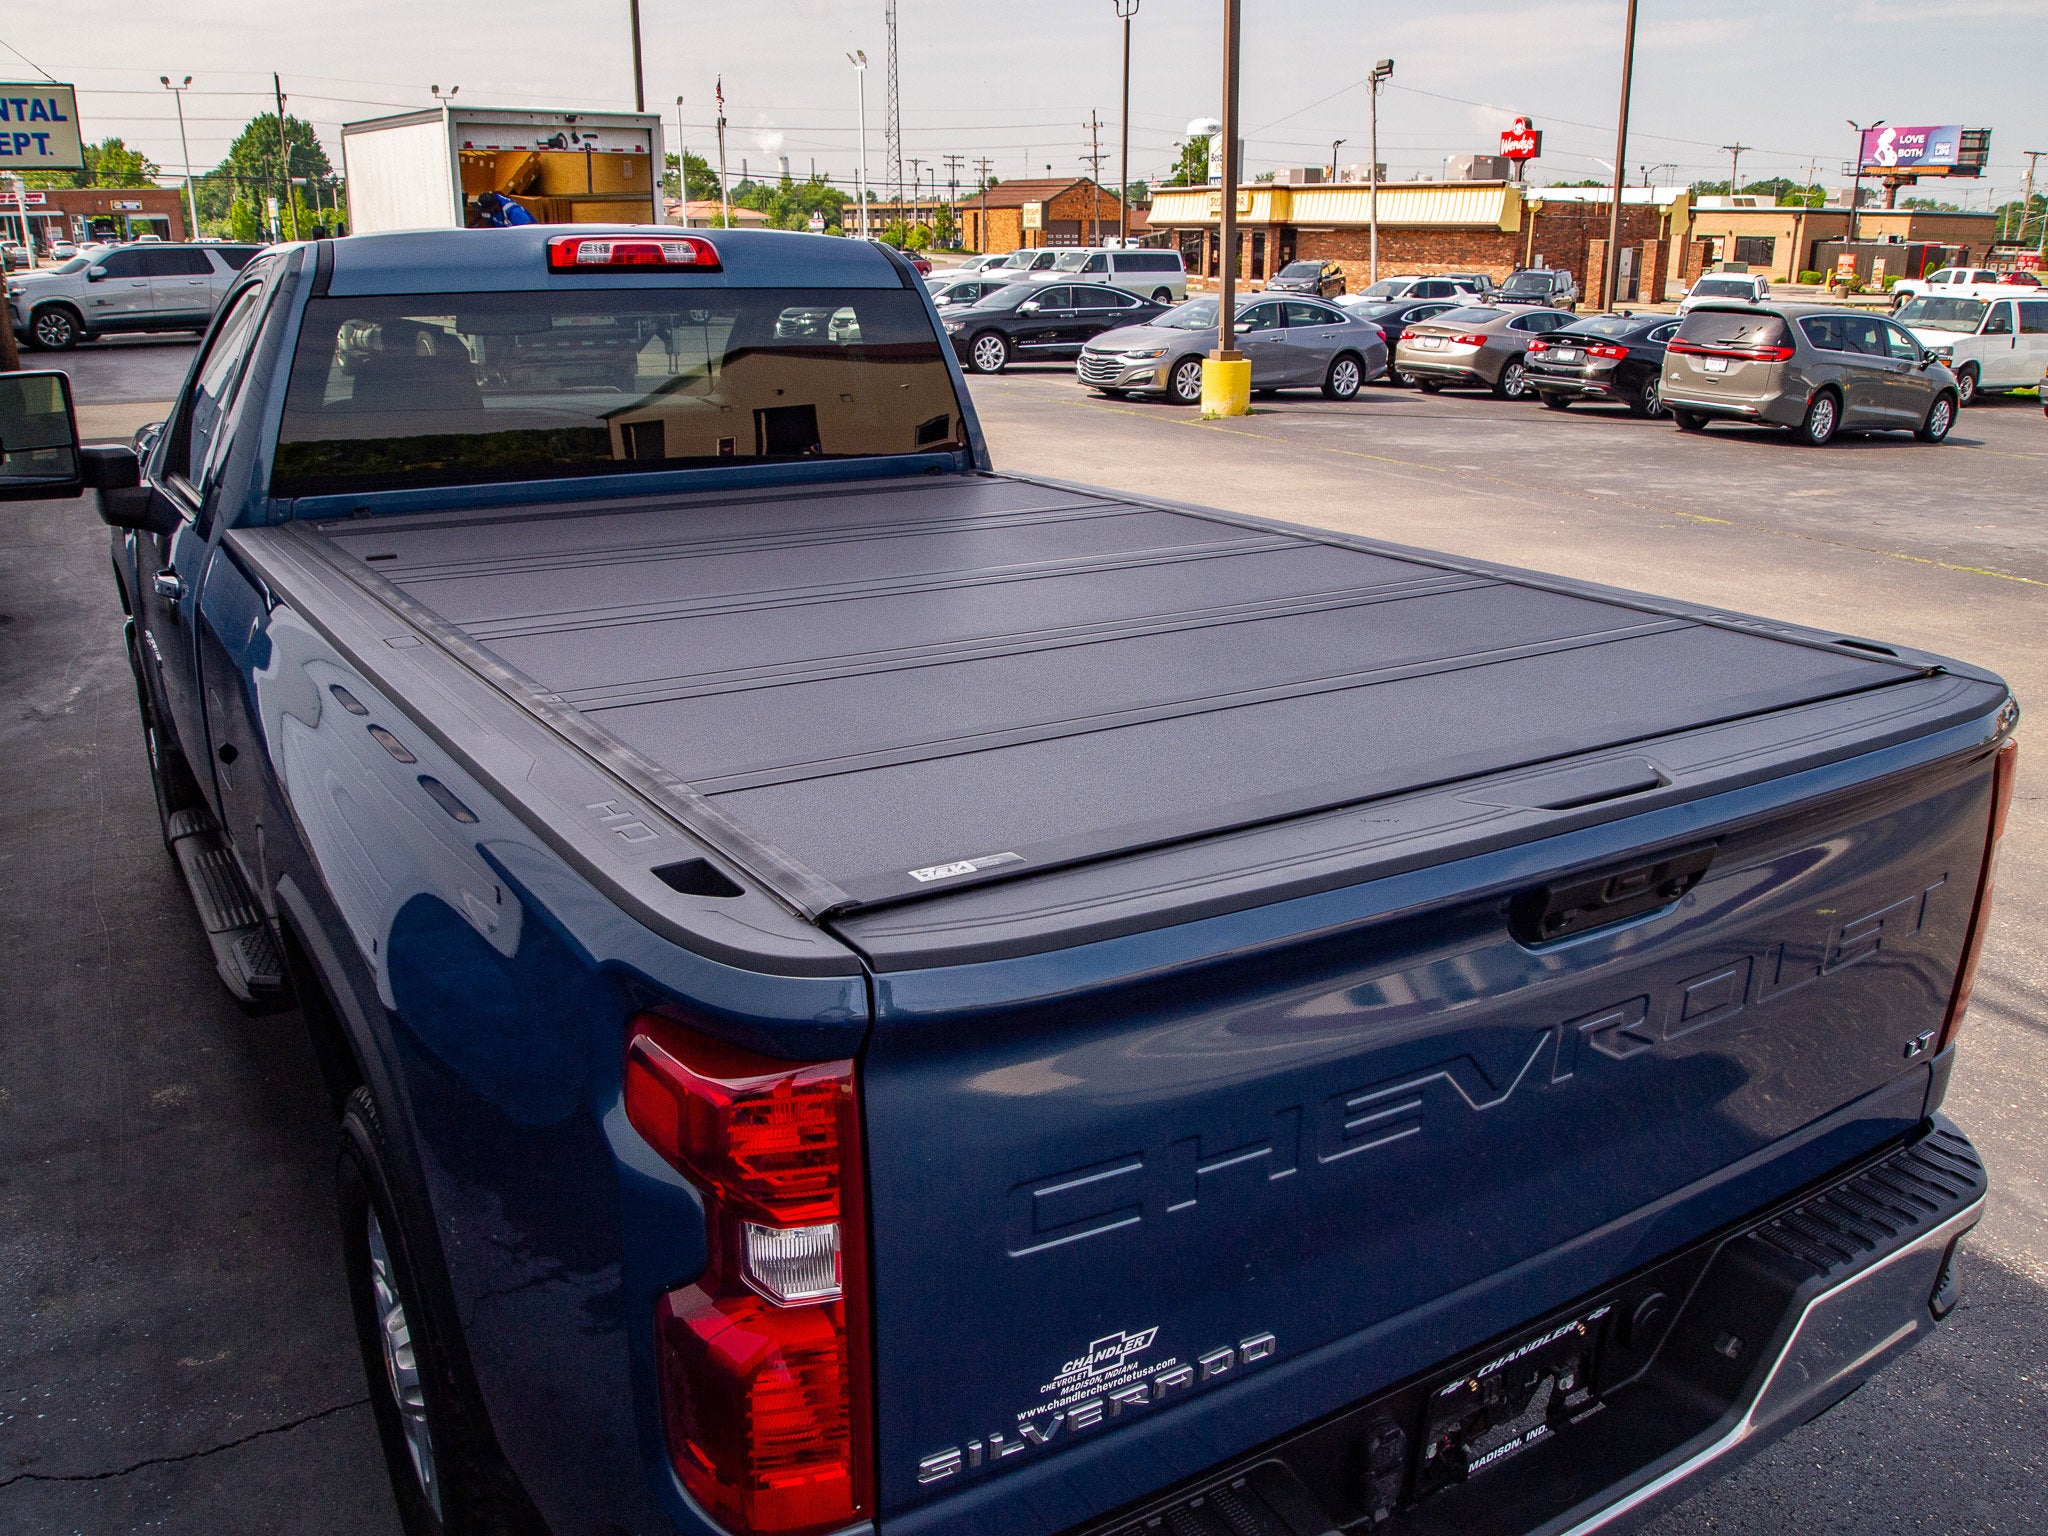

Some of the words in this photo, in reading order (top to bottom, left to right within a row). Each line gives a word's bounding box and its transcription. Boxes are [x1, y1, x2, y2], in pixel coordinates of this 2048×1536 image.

[1500, 134, 1535, 156] Wendy's
[1897, 148, 1923, 158] BOTH
[1899, 134, 1925, 144] LOVE
[1903, 1029, 1935, 1059] LT
[1006, 872, 1948, 1258] CHEVROLET
[1062, 1335, 1145, 1374] CHANDLER
[1477, 1320, 1579, 1378] CHANDLER
[1017, 1357, 1177, 1421] www.chandlerchevroletusa.com
[1040, 1371, 1089, 1394] CHEVROLET
[1060, 1375, 1103, 1396] MADISON,
[1104, 1361, 1139, 1381] INDIANA
[917, 1331, 1277, 1484] SILVERADO
[1526, 1424, 1549, 1442] IND.
